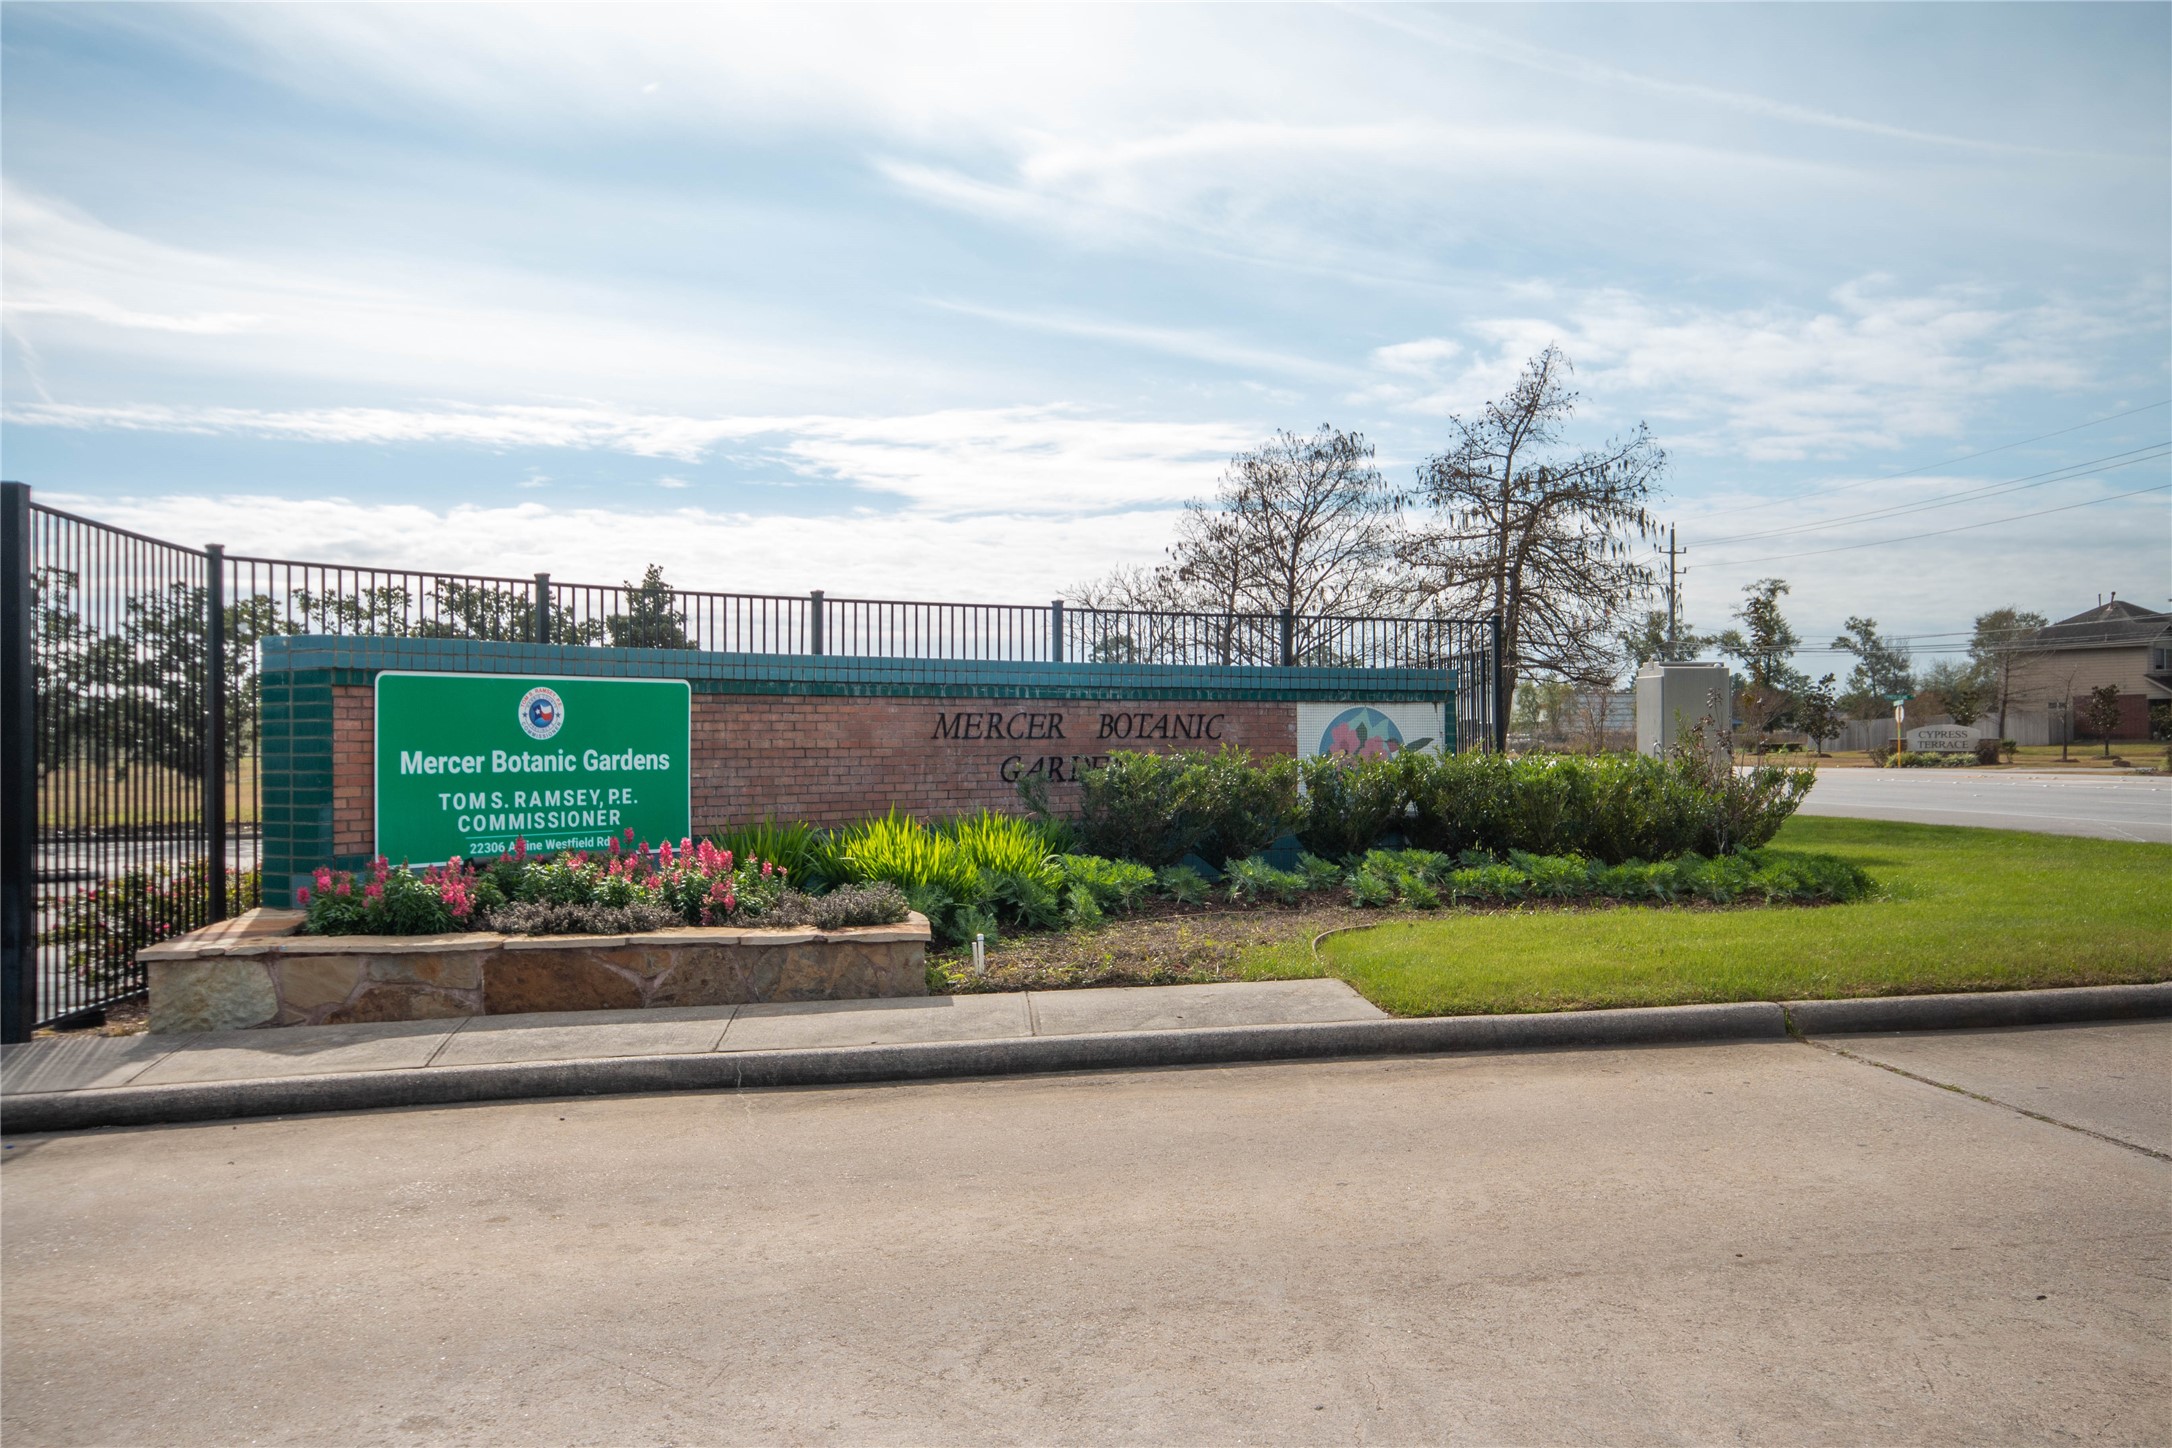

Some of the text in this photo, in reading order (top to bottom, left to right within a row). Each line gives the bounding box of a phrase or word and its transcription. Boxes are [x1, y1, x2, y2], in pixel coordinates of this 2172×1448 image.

[931, 712, 1224, 740] MERCER BOTANIC
[1918, 730, 1968, 739] CYPRESS
[1918, 740, 1969, 749] TERRACE
[400, 748, 670, 774] Mercer Botanic Gardens
[439, 788, 638, 811] TOM S. RAMSEY, P.E.
[458, 809, 621, 833] COMMISSIONER
[470, 836, 610, 854] 22306 Aine Westfield Rd
